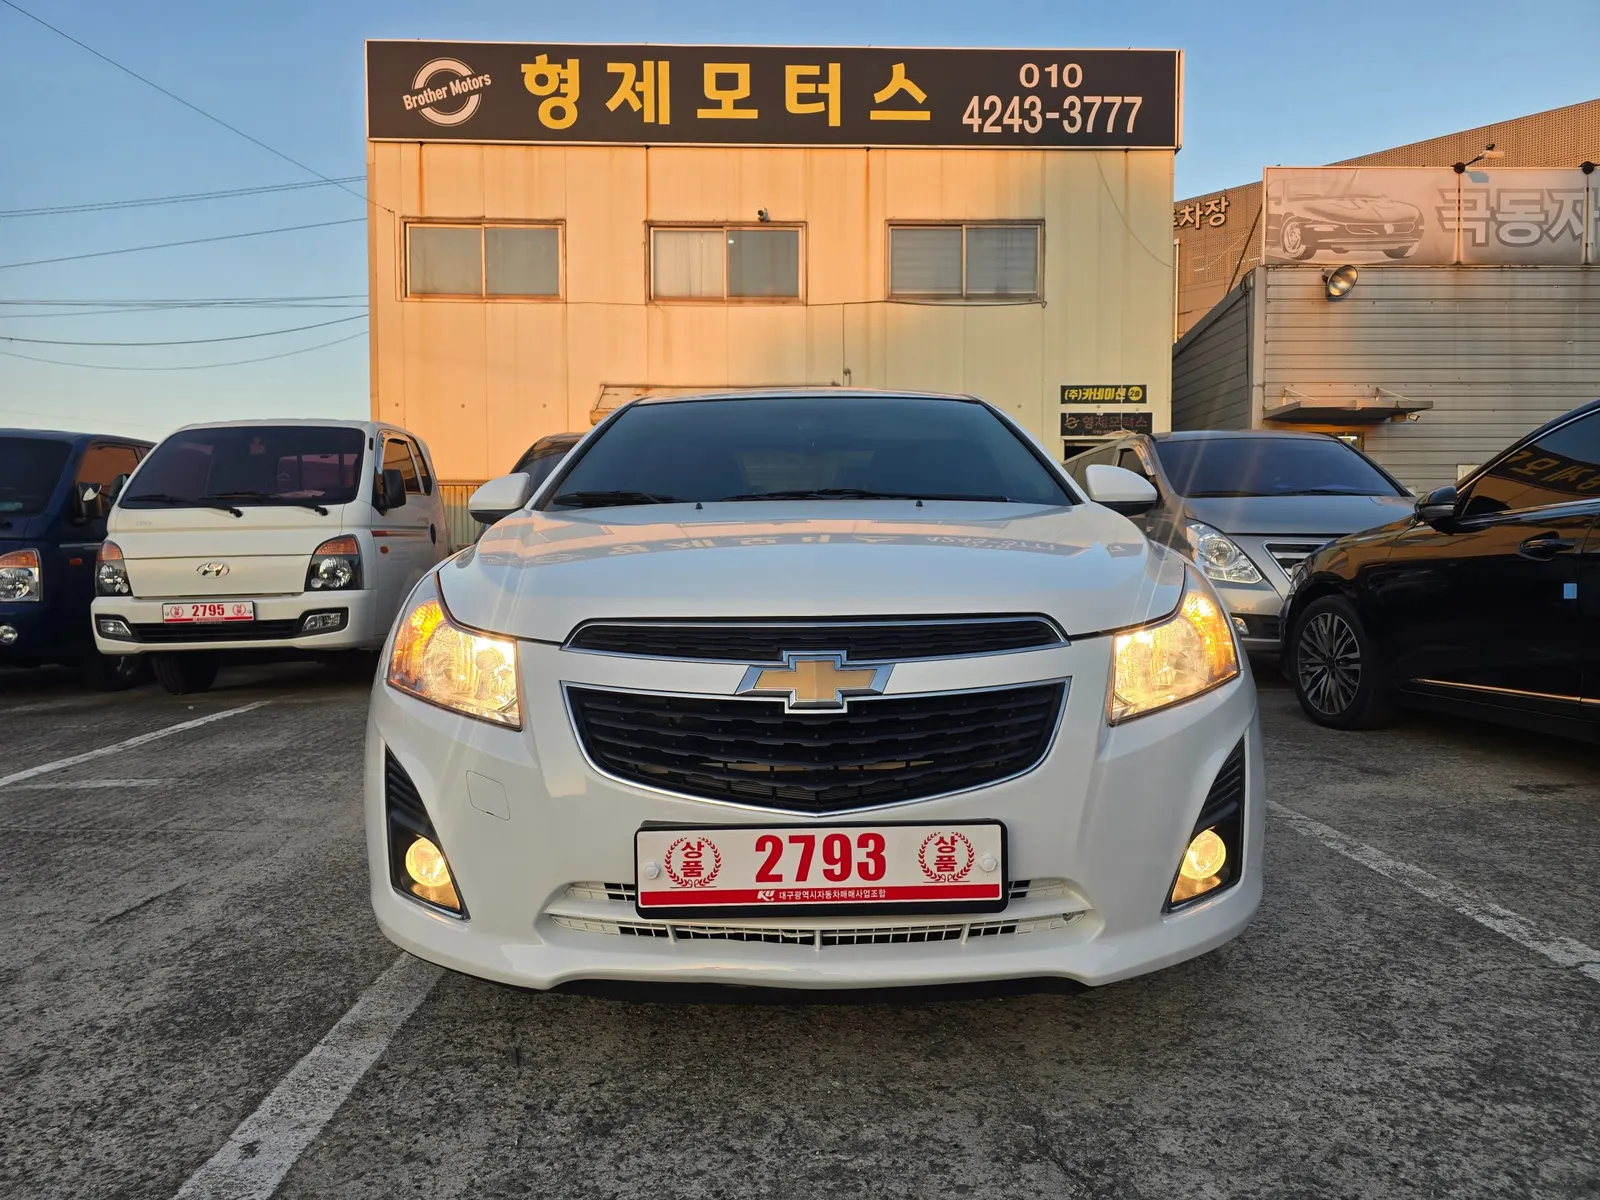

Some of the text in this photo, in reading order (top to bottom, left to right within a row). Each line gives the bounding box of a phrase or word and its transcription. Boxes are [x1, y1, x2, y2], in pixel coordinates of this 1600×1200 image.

[403, 71, 492, 111] Brother Motors
[1019, 63, 1083, 88] 010
[962, 95, 1143, 134] 4243-3777
[1064, 387, 1126, 400] (주)카네이션
[192, 604, 225, 617] 2795
[680, 840, 705, 878] 상품
[755, 832, 886, 883] 2793
[934, 835, 959, 873] 상품
